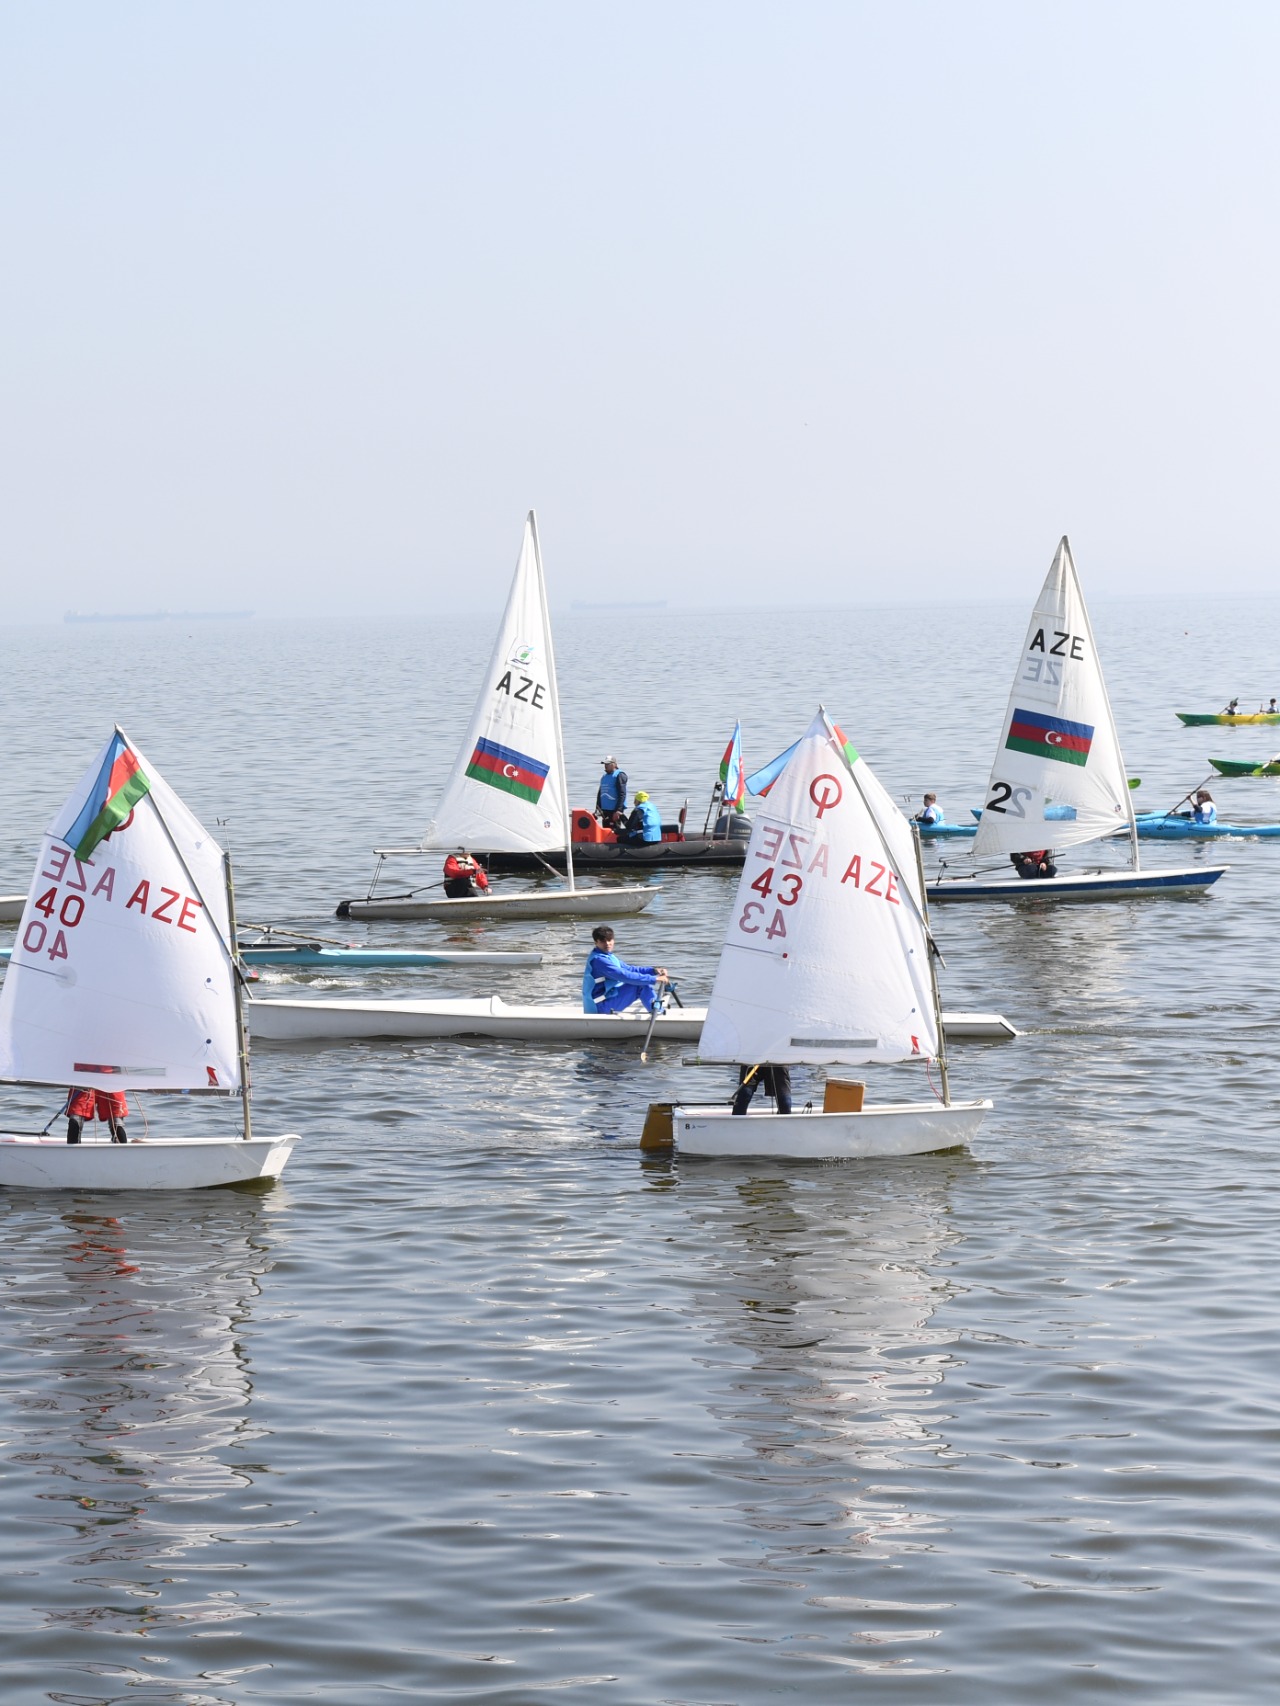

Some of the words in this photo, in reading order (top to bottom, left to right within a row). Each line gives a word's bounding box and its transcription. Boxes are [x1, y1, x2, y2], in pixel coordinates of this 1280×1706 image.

[1029, 628, 1085, 661] AZE
[495, 670, 546, 710] AZE
[986, 782, 1012, 814] 2
[751, 867, 803, 906] 43
[840, 854, 900, 905] AZE
[34, 886, 85, 928] 40
[125, 879, 202, 933] AZE
